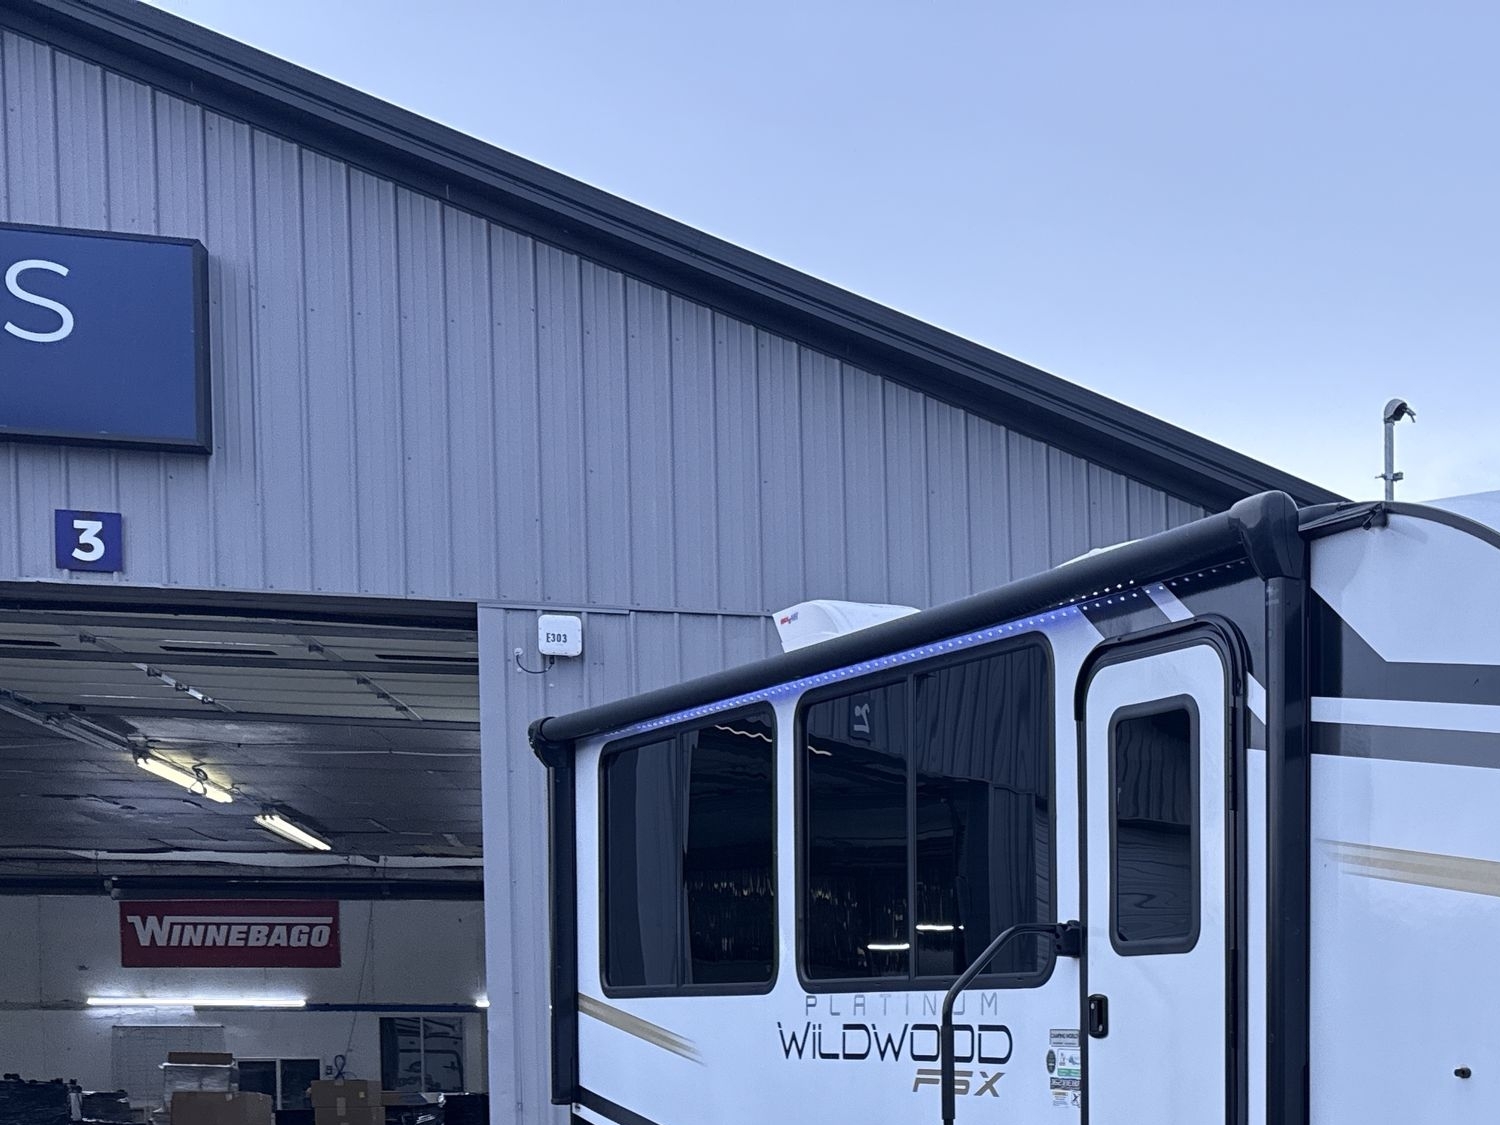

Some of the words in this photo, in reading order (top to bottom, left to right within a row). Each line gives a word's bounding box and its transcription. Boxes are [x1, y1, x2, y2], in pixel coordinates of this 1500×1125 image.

[4, 259, 74, 342] S
[72, 519, 105, 562] 3
[546, 632, 568, 643] E303
[127, 915, 333, 947] WINNEBAGO
[805, 992, 998, 1016] PLATINUM
[912, 1068, 1006, 1098] FSX
